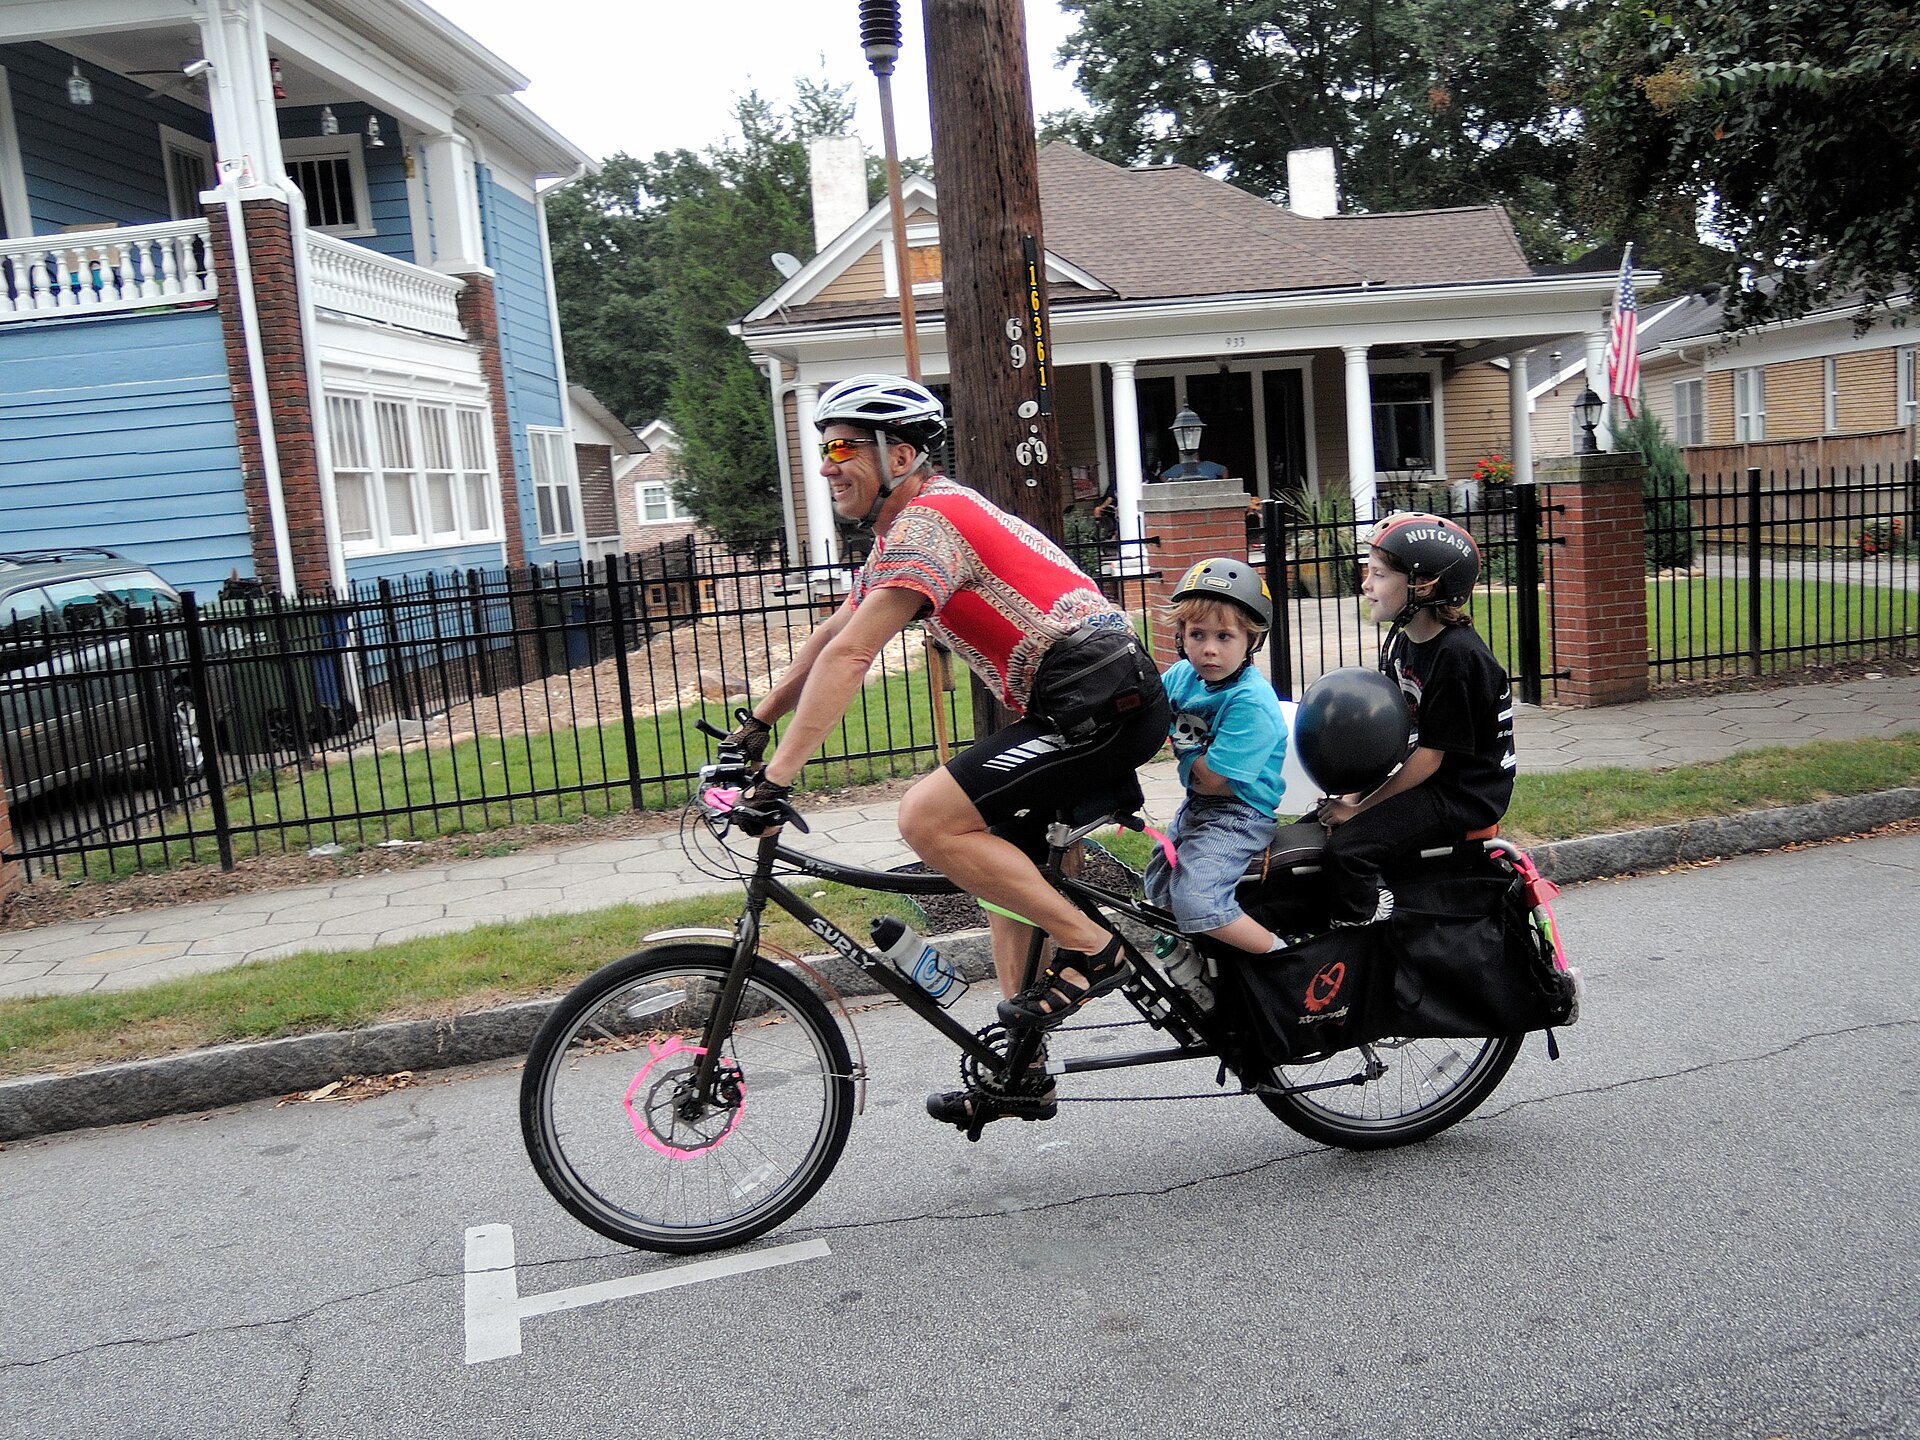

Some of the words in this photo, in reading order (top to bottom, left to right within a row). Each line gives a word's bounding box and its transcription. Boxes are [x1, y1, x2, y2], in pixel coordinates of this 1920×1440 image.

[1029, 265, 1047, 387] 16361
[1225, 336, 1246, 348] 933
[1015, 440, 1049, 467] 69
[1405, 528, 1472, 557] NUTCASE
[809, 917, 876, 970] SURLY
